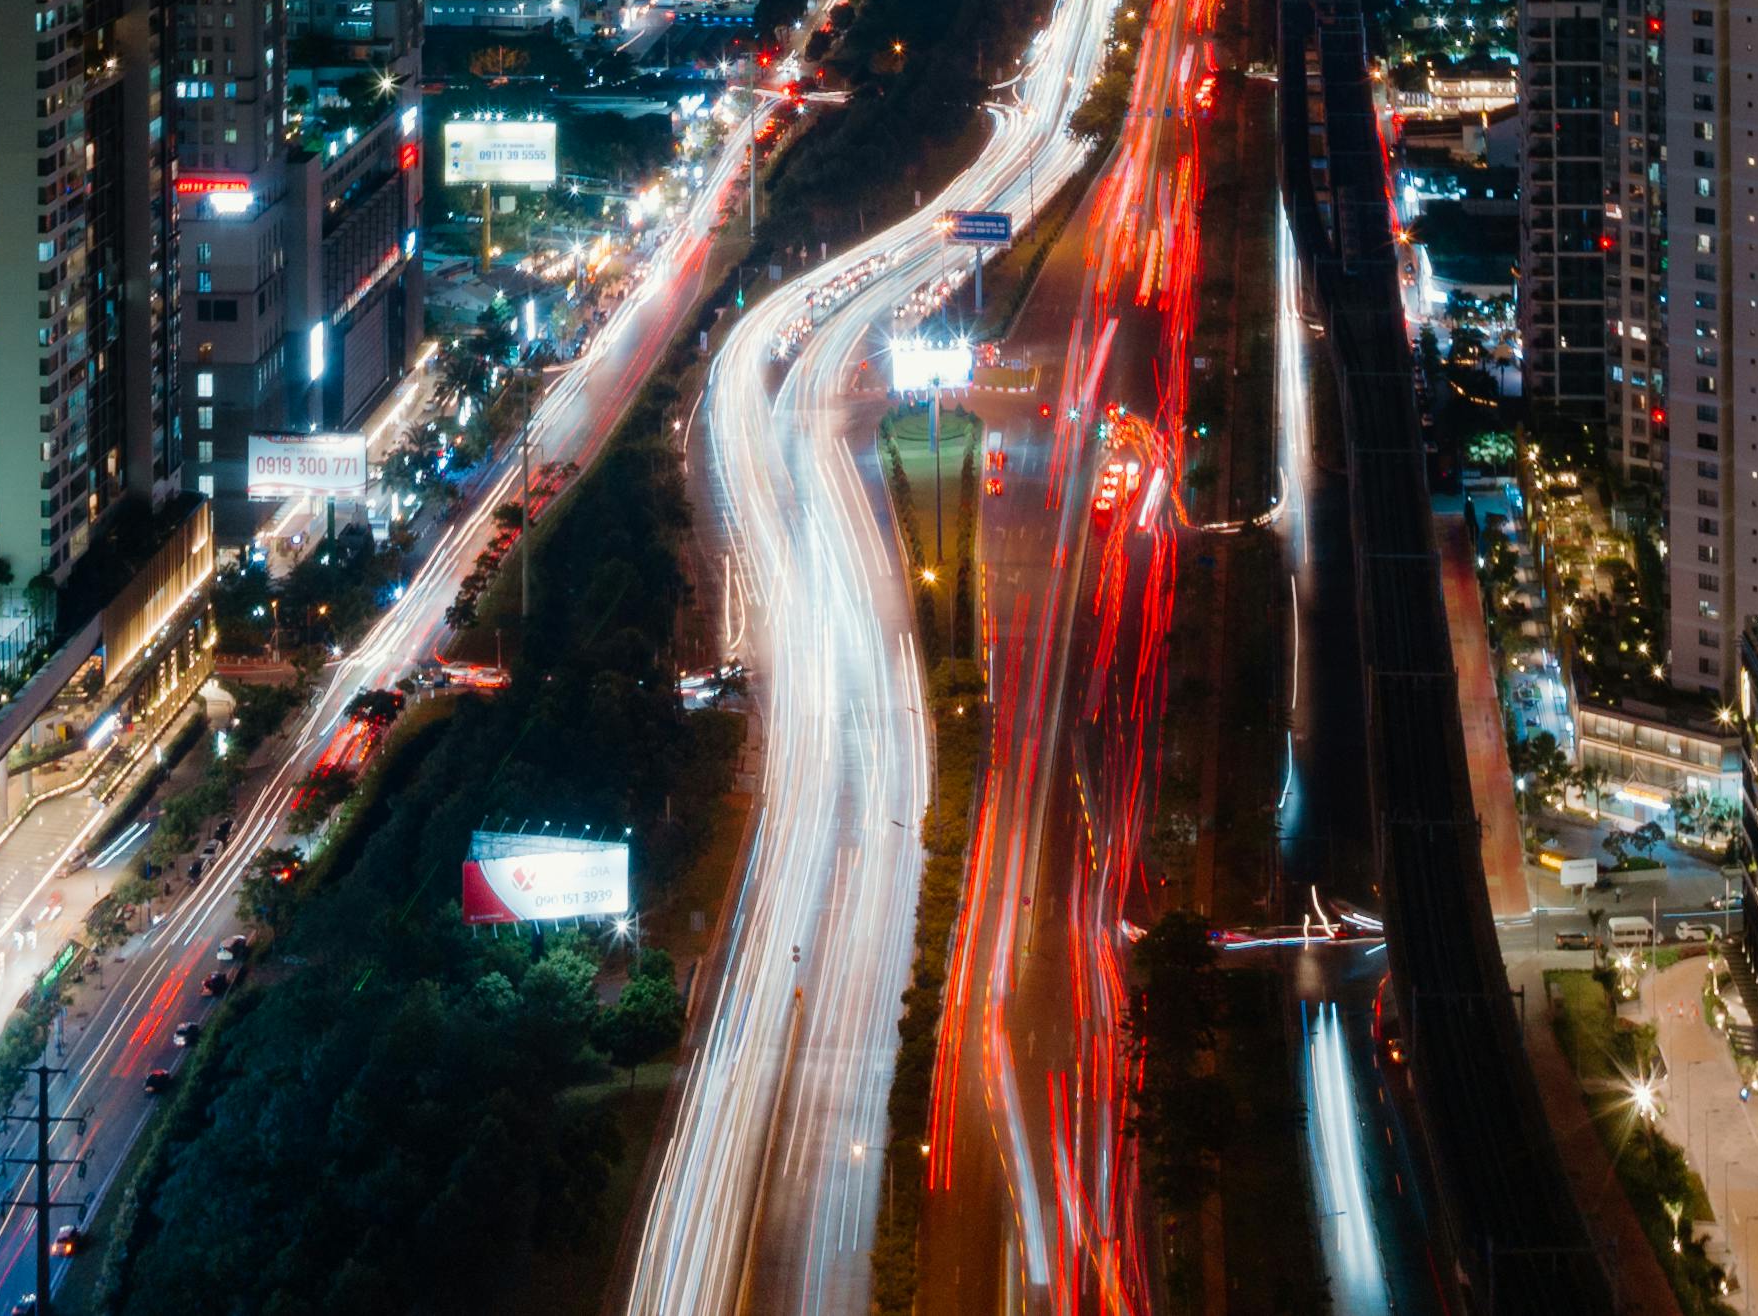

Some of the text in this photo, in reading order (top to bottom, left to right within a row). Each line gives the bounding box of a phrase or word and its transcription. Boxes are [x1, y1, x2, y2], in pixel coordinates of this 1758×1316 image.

[479, 151, 547, 161] 0911 39 5555
[256, 456, 358, 476] 0919 300 771
[562, 893, 579, 905] 151
[583, 889, 613, 904] 3939
